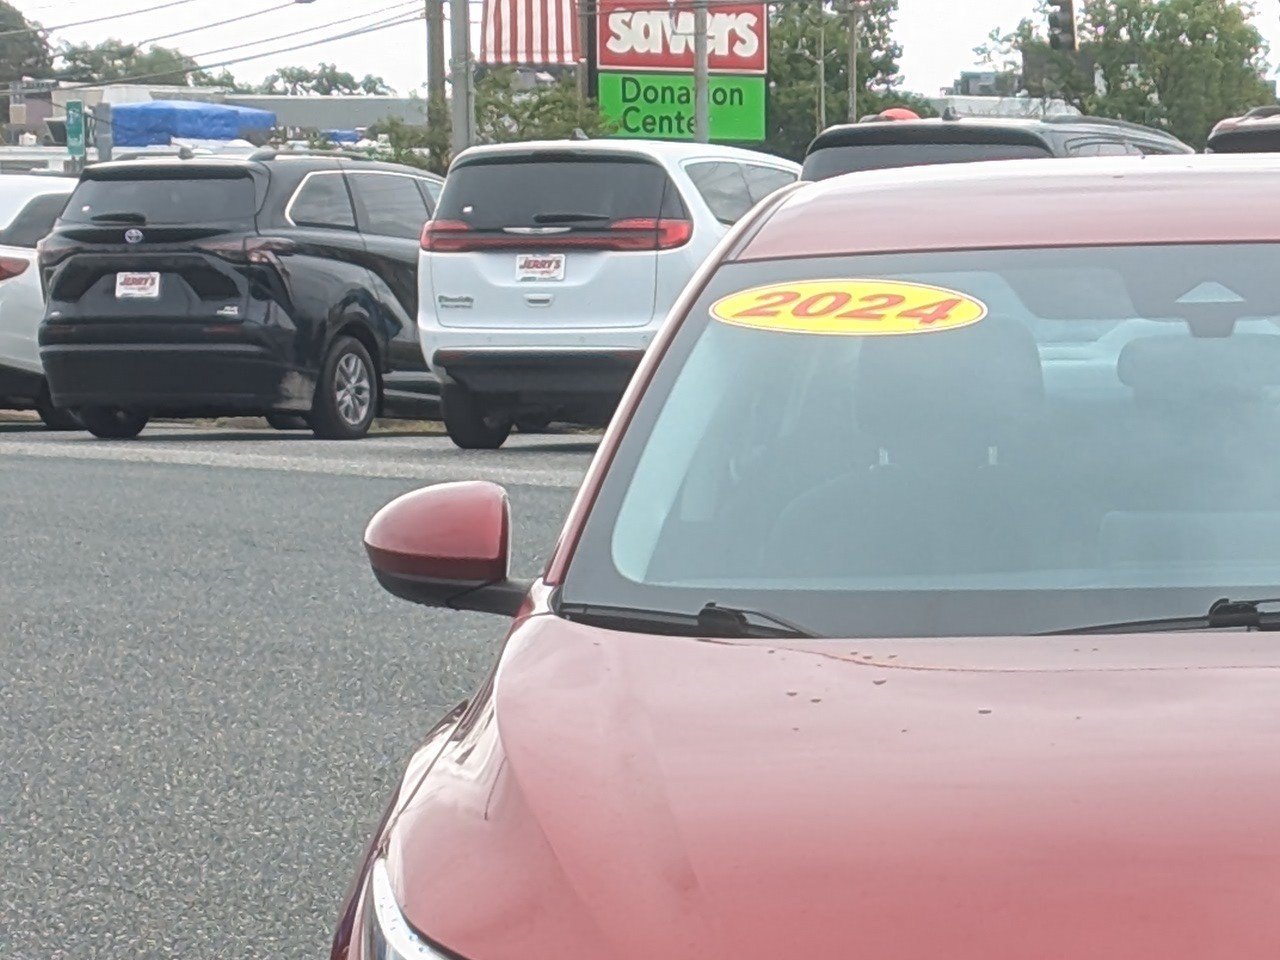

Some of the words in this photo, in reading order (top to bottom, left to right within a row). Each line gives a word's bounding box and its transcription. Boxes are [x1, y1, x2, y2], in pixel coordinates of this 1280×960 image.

[621, 76, 744, 106] Donaon
[622, 106, 696, 135] Cente
[732, 291, 962, 325] 2024
